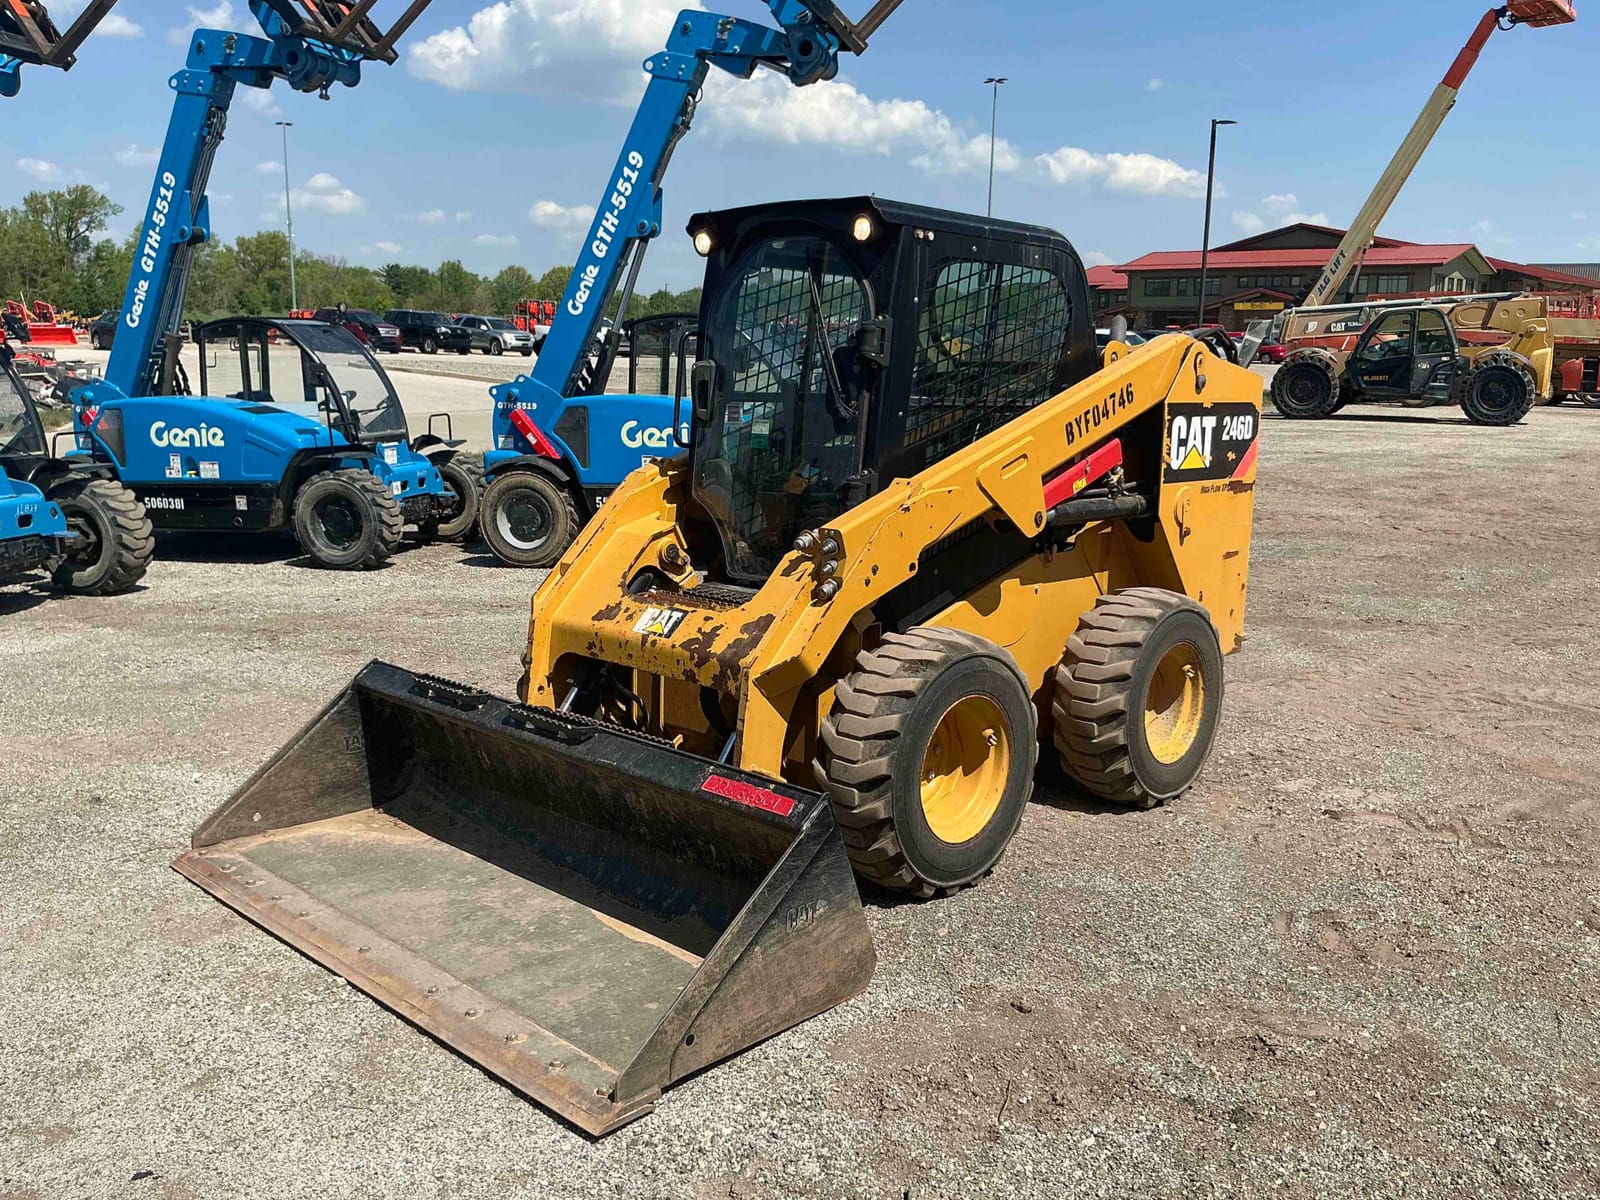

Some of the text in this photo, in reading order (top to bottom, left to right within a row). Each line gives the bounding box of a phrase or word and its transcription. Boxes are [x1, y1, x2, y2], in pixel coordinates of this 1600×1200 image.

[567, 150, 644, 316] Genie GTH-5519
[126, 171, 176, 328] Genie GTH-5519
[1317, 249, 1346, 297] JLG LIFT
[1331, 322, 1345, 332] CAT
[497, 401, 537, 410] GTH-5519
[1065, 382, 1134, 446] BYF04746
[150, 421, 225, 448] Genie
[620, 420, 690, 449] Geni
[1170, 415, 1254, 470] CAT 246D
[144, 496, 185, 510] 5060381
[633, 606, 684, 636] CAT
